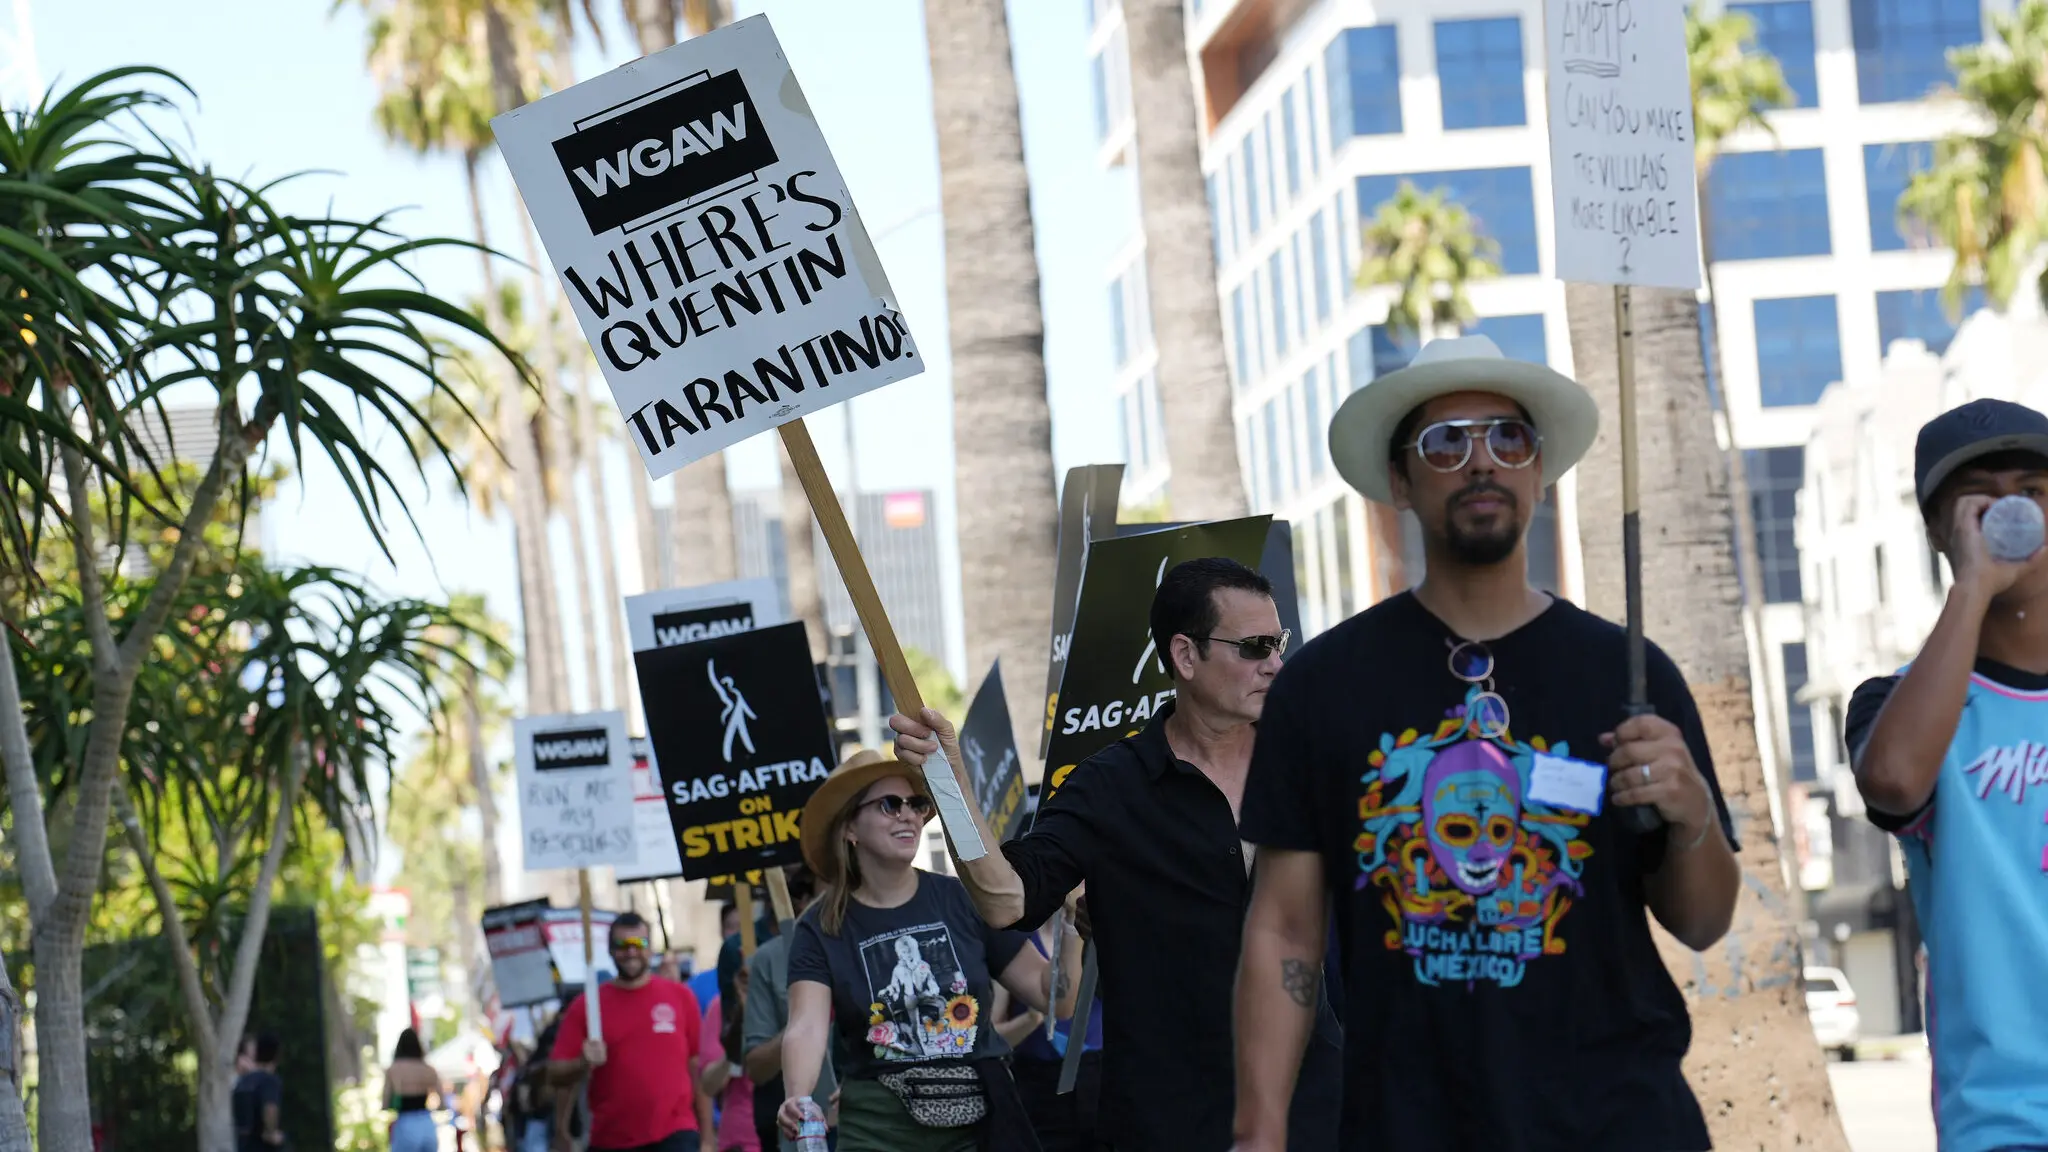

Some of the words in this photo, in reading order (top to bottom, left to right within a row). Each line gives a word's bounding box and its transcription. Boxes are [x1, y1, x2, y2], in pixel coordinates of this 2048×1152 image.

[1564, 82, 1598, 130] CAN
[1600, 88, 1640, 135] YOU
[1646, 106, 1686, 142] MAKE
[572, 101, 749, 199] WGAW
[1611, 197, 1680, 238] LIKABLE
[563, 170, 842, 321] WHERE'S
[600, 232, 848, 373] QUENTIN
[656, 616, 752, 647] WGAW
[738, 795, 773, 816] ON
[682, 809, 804, 859] STRIK
[1403, 921, 1472, 951] UCHA
